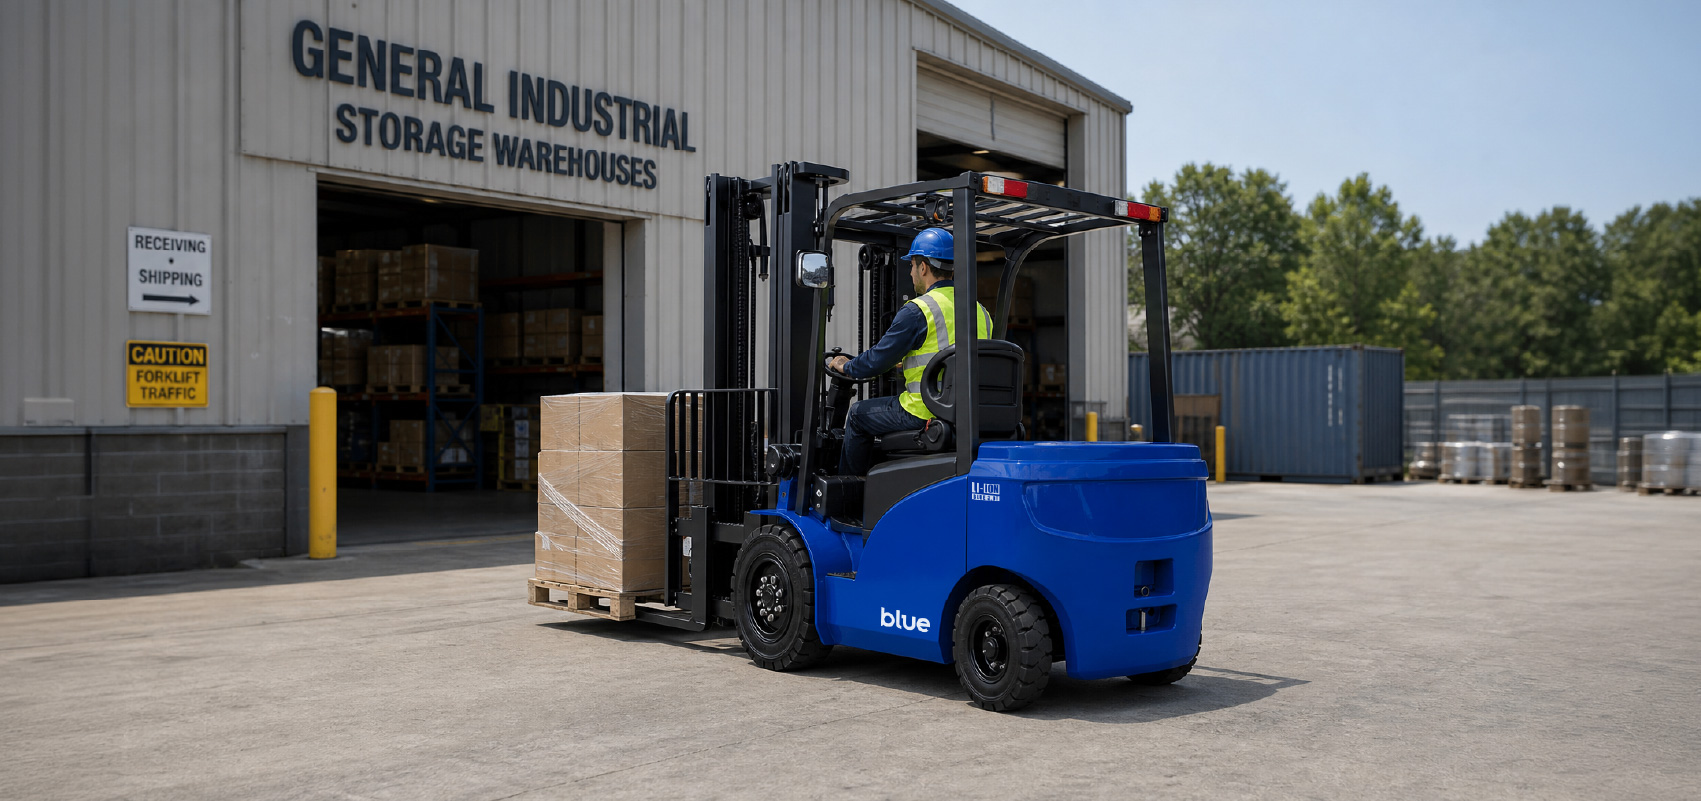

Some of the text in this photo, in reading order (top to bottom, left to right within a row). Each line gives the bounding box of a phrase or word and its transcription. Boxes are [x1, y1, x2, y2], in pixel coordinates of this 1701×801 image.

[292, 20, 696, 152] GENERAL INDUSTRIAL
[336, 103, 657, 189] STORAGE WAREHOUSES
[135, 235, 206, 253] RECEIVING
[139, 269, 202, 287] SHIPPING
[131, 346, 204, 365] CAUTION
[136, 370, 201, 384] FORKLIFT
[140, 386, 197, 400] TRAFFIC
[971, 481, 1000, 495] LI-ION
[880, 606, 931, 633] blue
